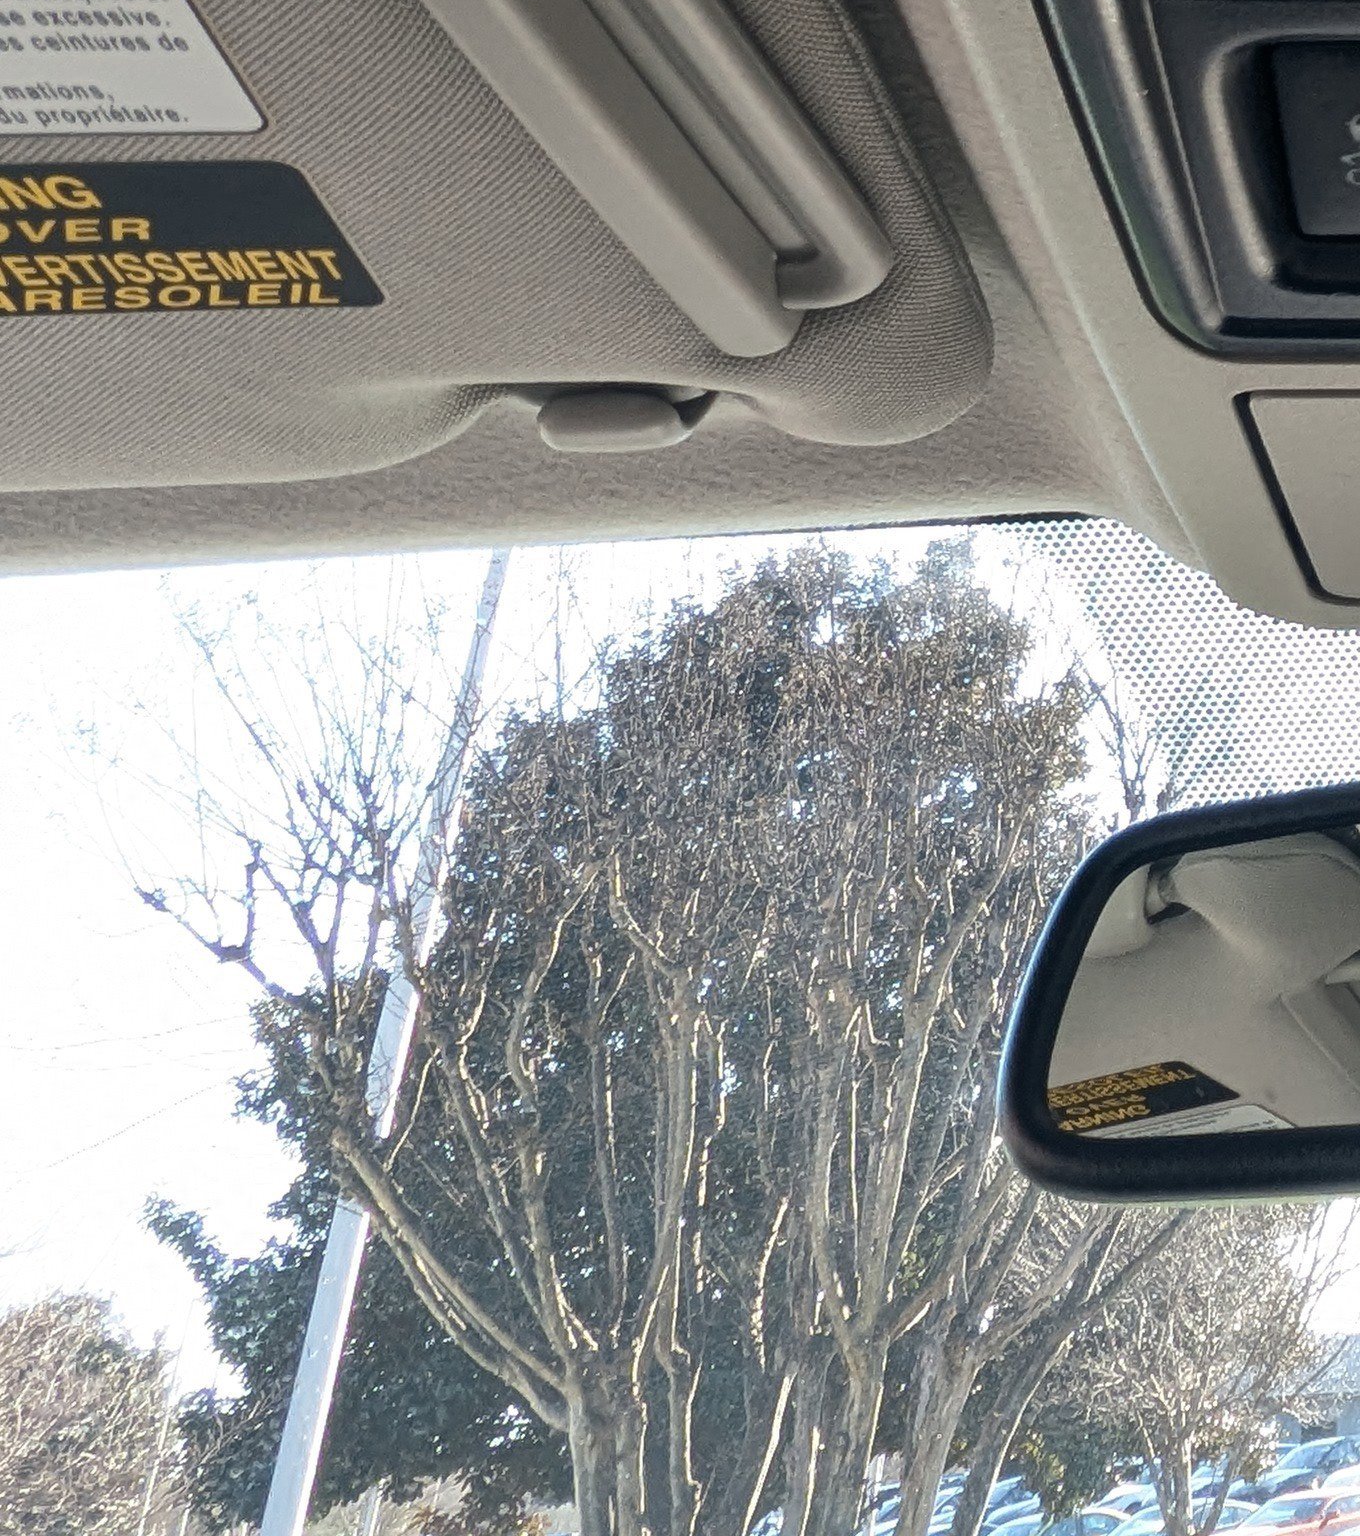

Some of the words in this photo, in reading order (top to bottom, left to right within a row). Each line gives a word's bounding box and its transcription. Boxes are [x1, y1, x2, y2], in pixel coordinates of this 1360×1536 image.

[32, 6, 170, 27] excessive.
[31, 32, 151, 52] ceintures
[158, 32, 189, 52] de
[2, 81, 115, 104] mations,
[35, 104, 189, 128] propriétaire.
[0, 218, 150, 244] VER
